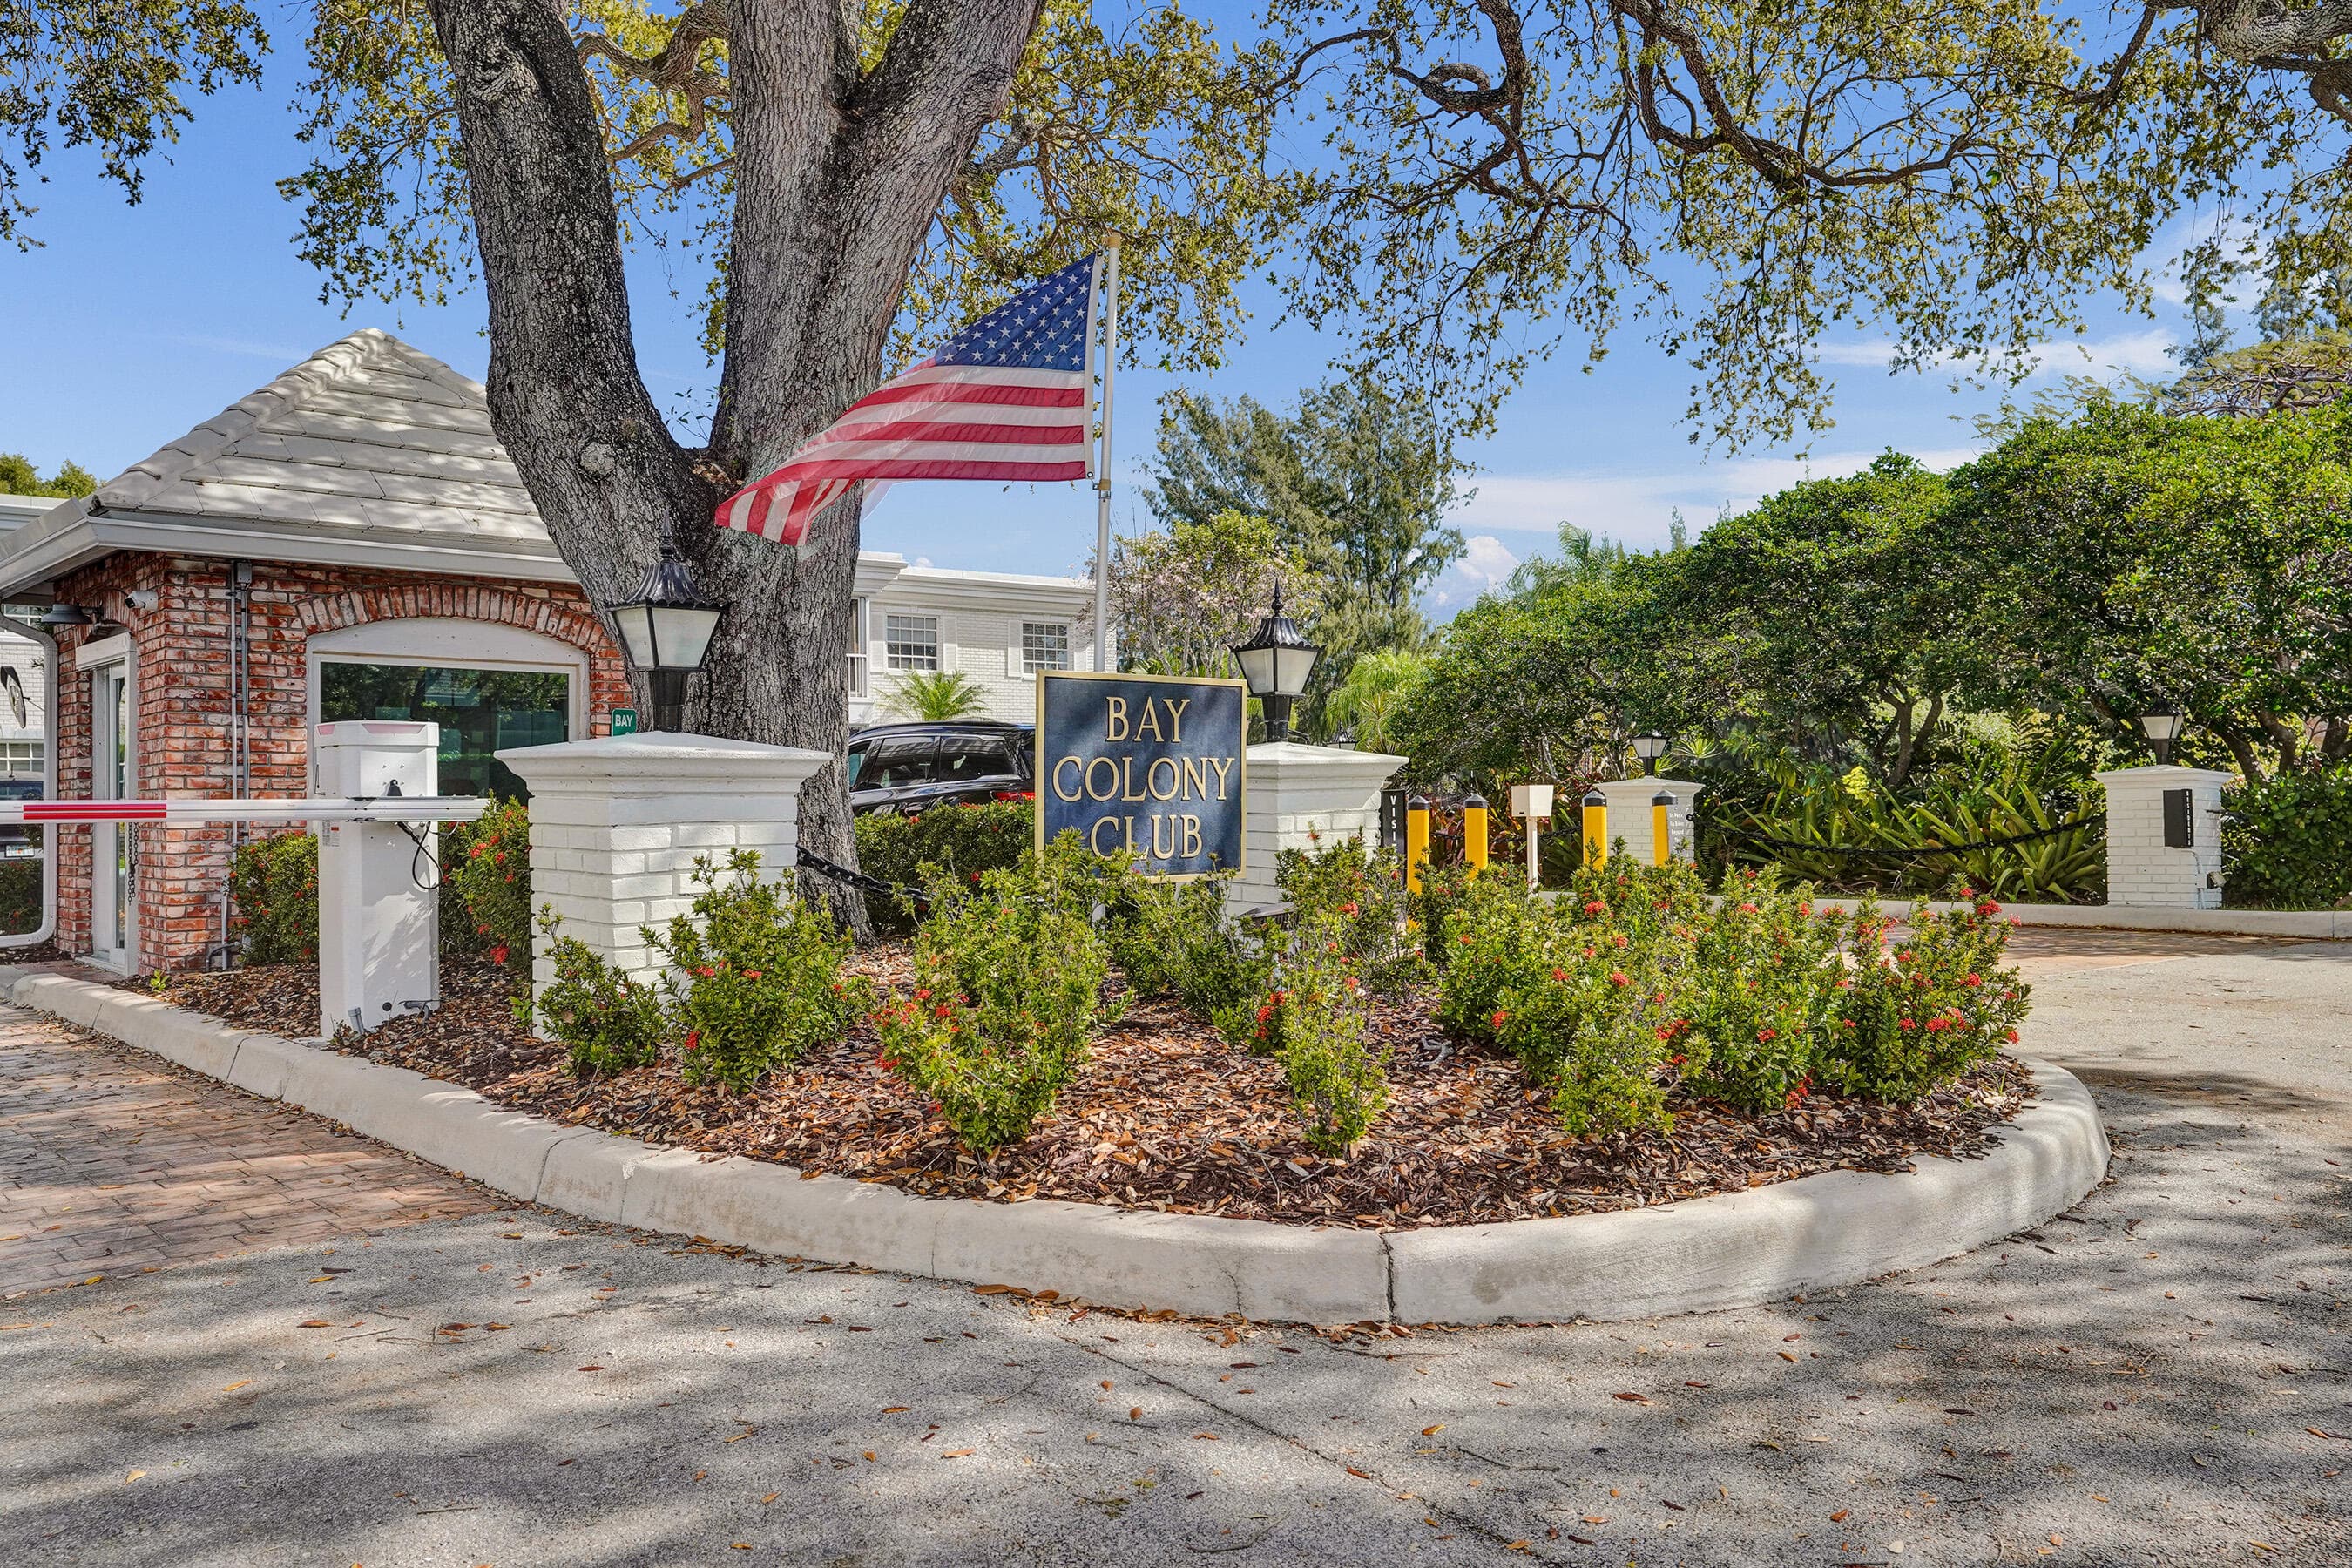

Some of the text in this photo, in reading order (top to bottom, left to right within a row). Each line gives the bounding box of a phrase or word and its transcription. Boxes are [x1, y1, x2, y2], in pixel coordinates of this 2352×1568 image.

[615, 714, 633, 727] BAY
[1105, 696, 1191, 742] BAY
[1052, 755, 1235, 802] COLONY
[1091, 814, 1203, 860] CLUB
